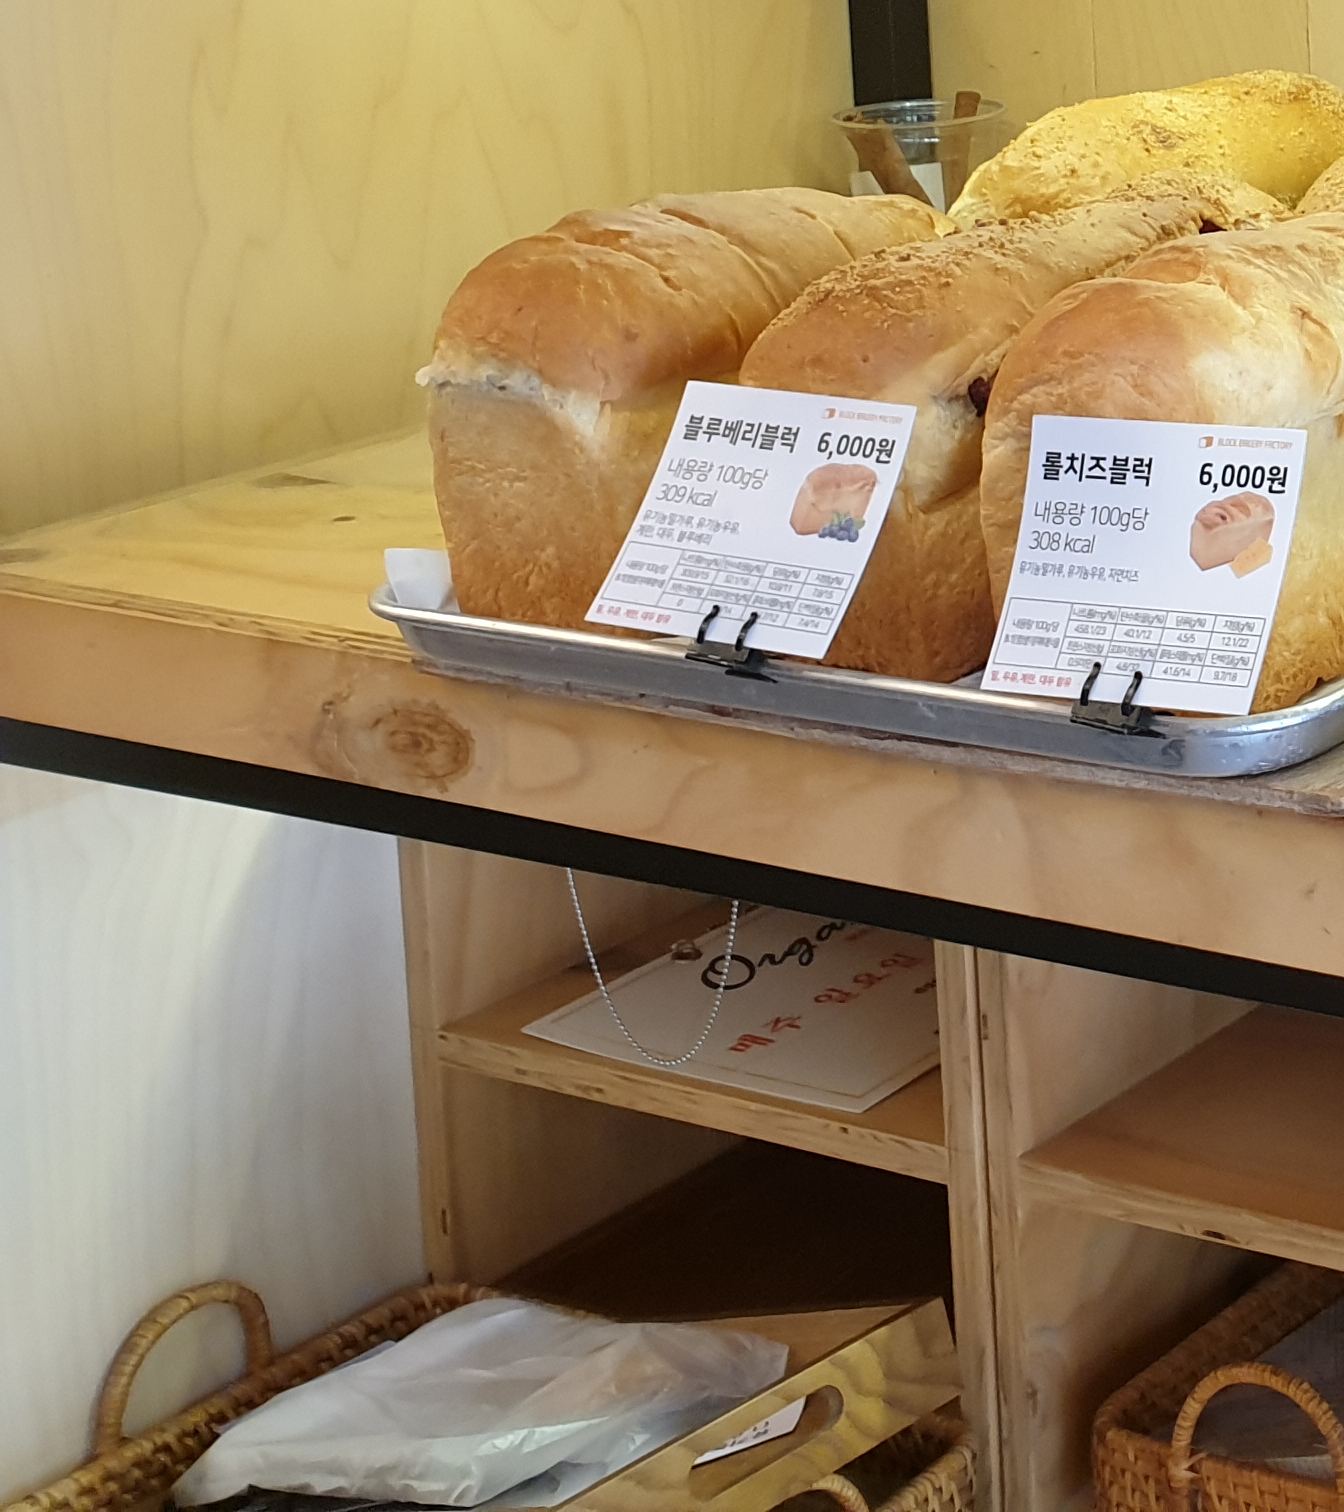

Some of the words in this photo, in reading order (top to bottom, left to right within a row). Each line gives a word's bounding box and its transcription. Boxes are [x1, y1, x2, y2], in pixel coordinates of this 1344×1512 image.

[683, 414, 800, 453] 블루베리블럭
[817, 432, 896, 464] 6,000원
[667, 458, 714, 481] 내용량
[717, 465, 768, 490] 100g당
[1042, 451, 1153, 486] 롤치즈블럭
[1199, 462, 1288, 494] 6,000원
[656, 484, 688, 503] 309
[687, 488, 717, 507] kcal
[1034, 500, 1085, 526] 내용량
[1090, 506, 1149, 531] 100g당
[1029, 531, 1060, 551] 308
[1063, 534, 1096, 554] kcal
